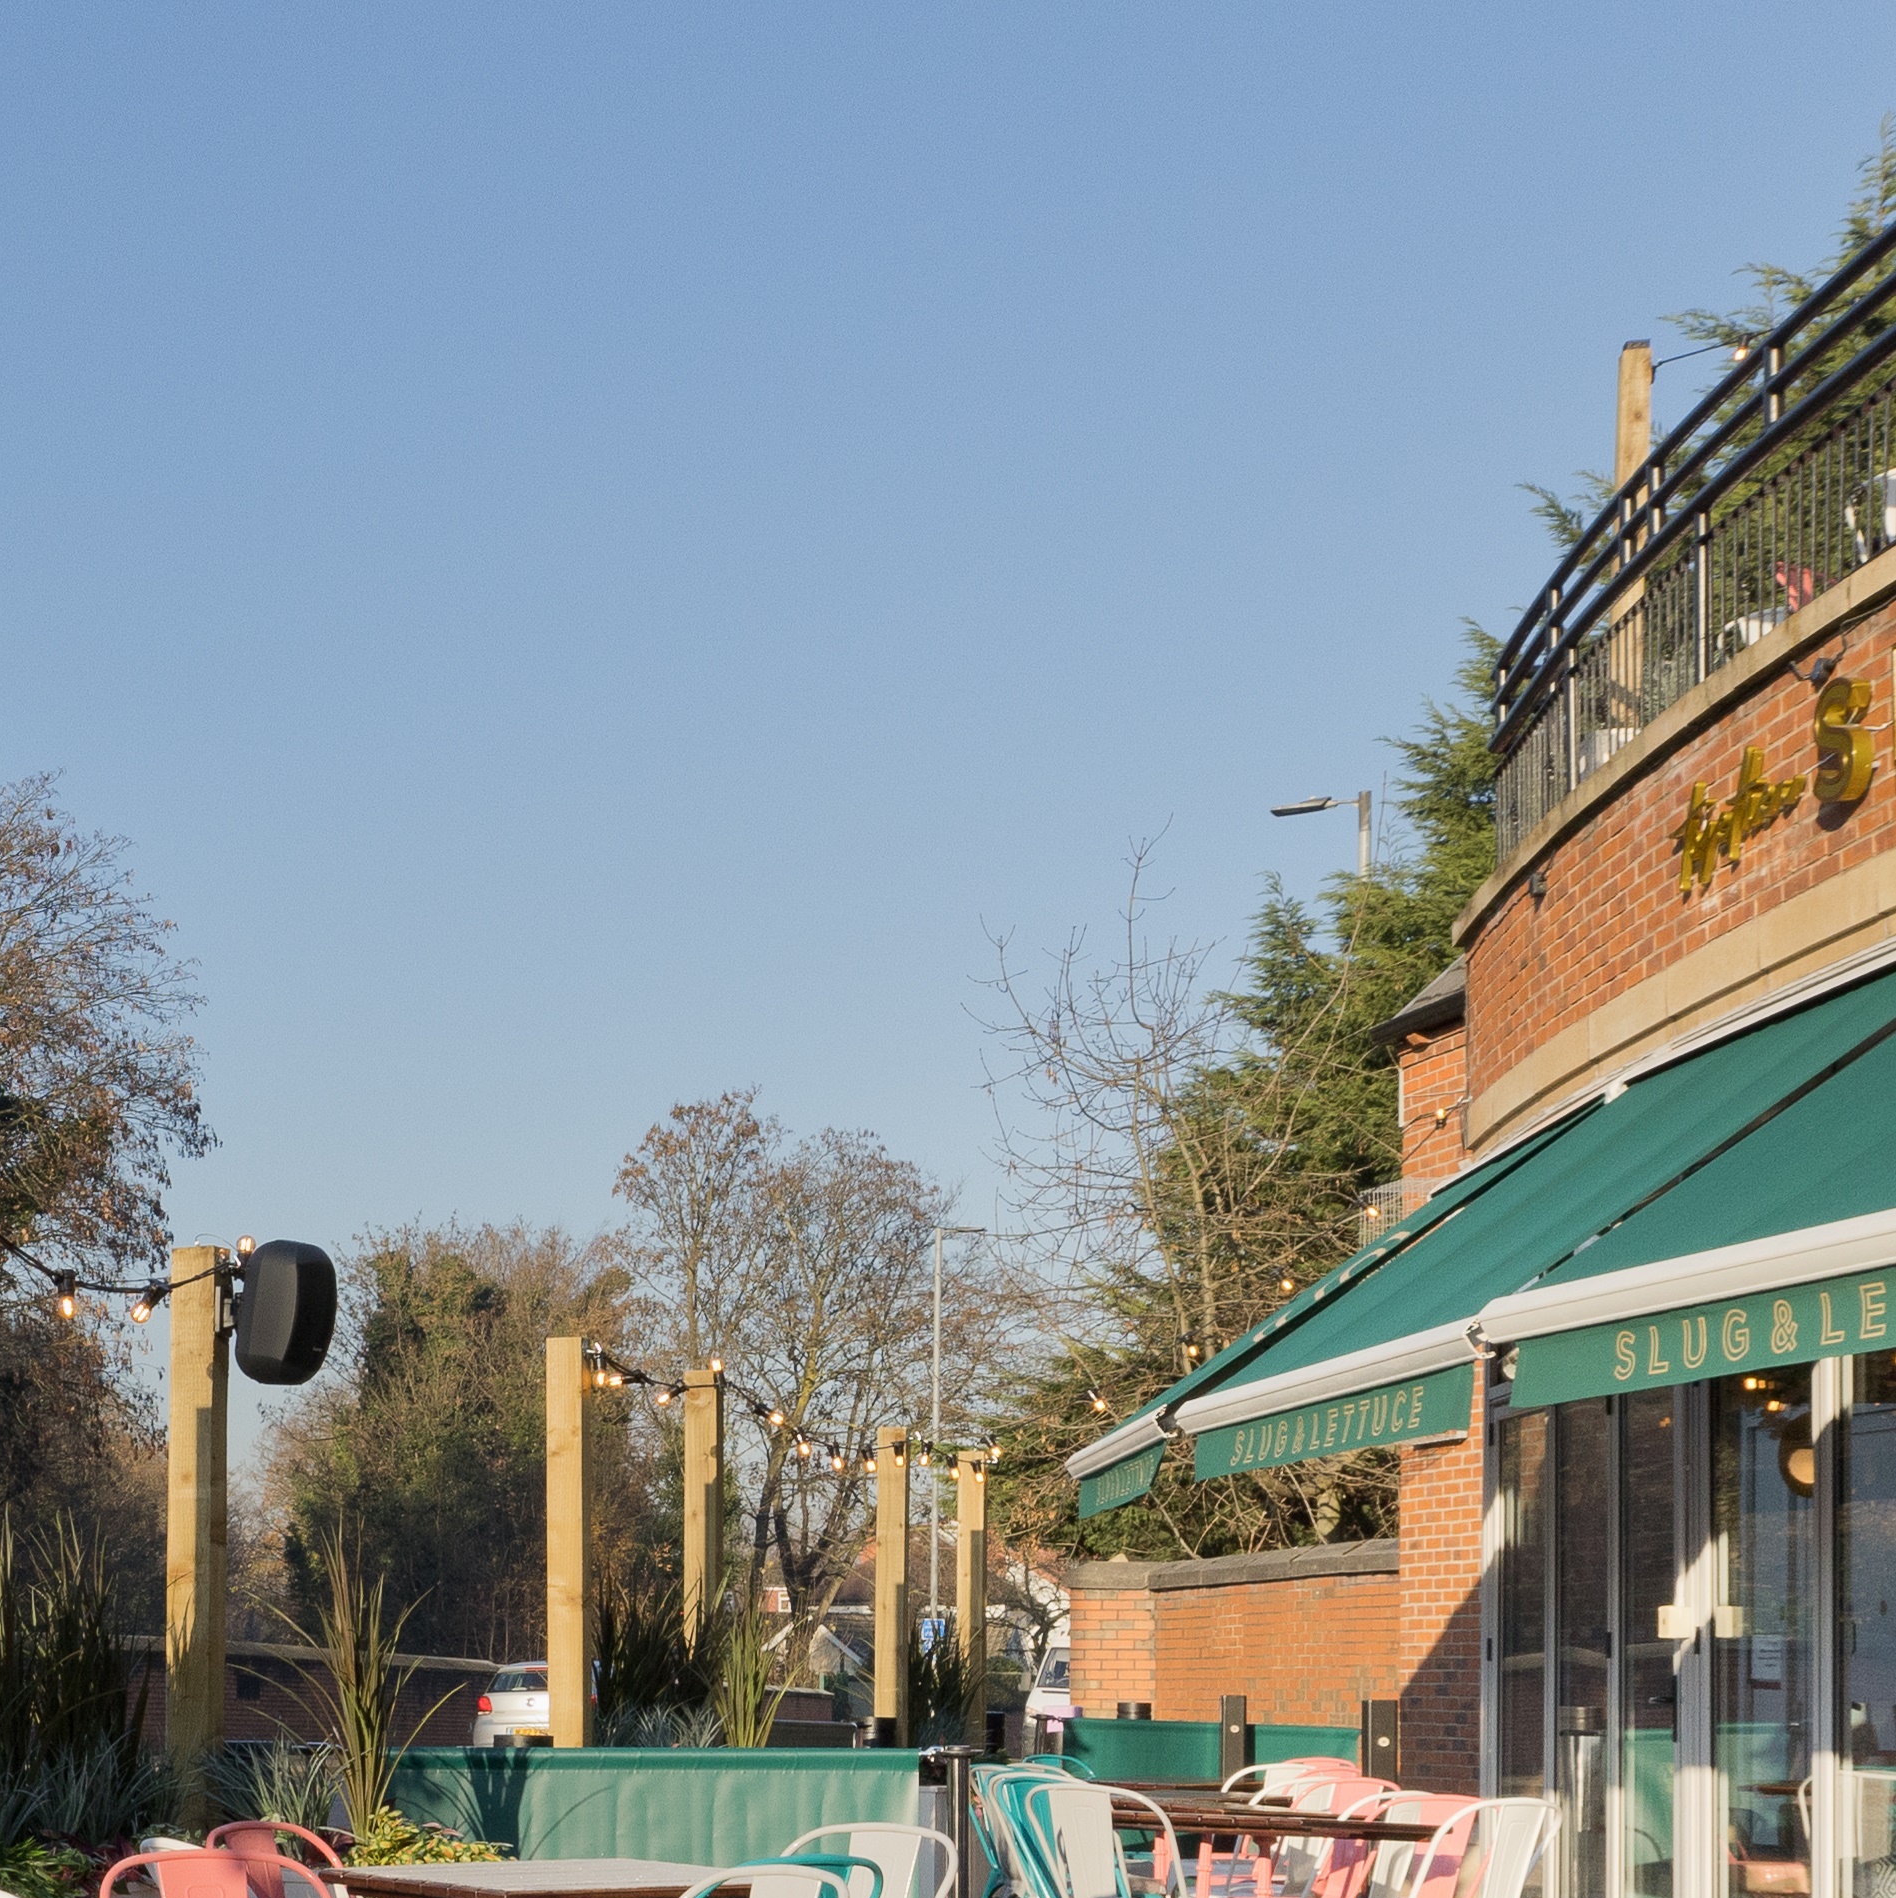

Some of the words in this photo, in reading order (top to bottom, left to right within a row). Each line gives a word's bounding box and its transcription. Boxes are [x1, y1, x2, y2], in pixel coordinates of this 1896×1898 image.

[1613, 1308, 1750, 1381] SLUG
[1770, 1299, 1799, 1355] &
[1229, 1420, 1289, 1467] SLUG
[1308, 1385, 1425, 1451] LETTUCE
